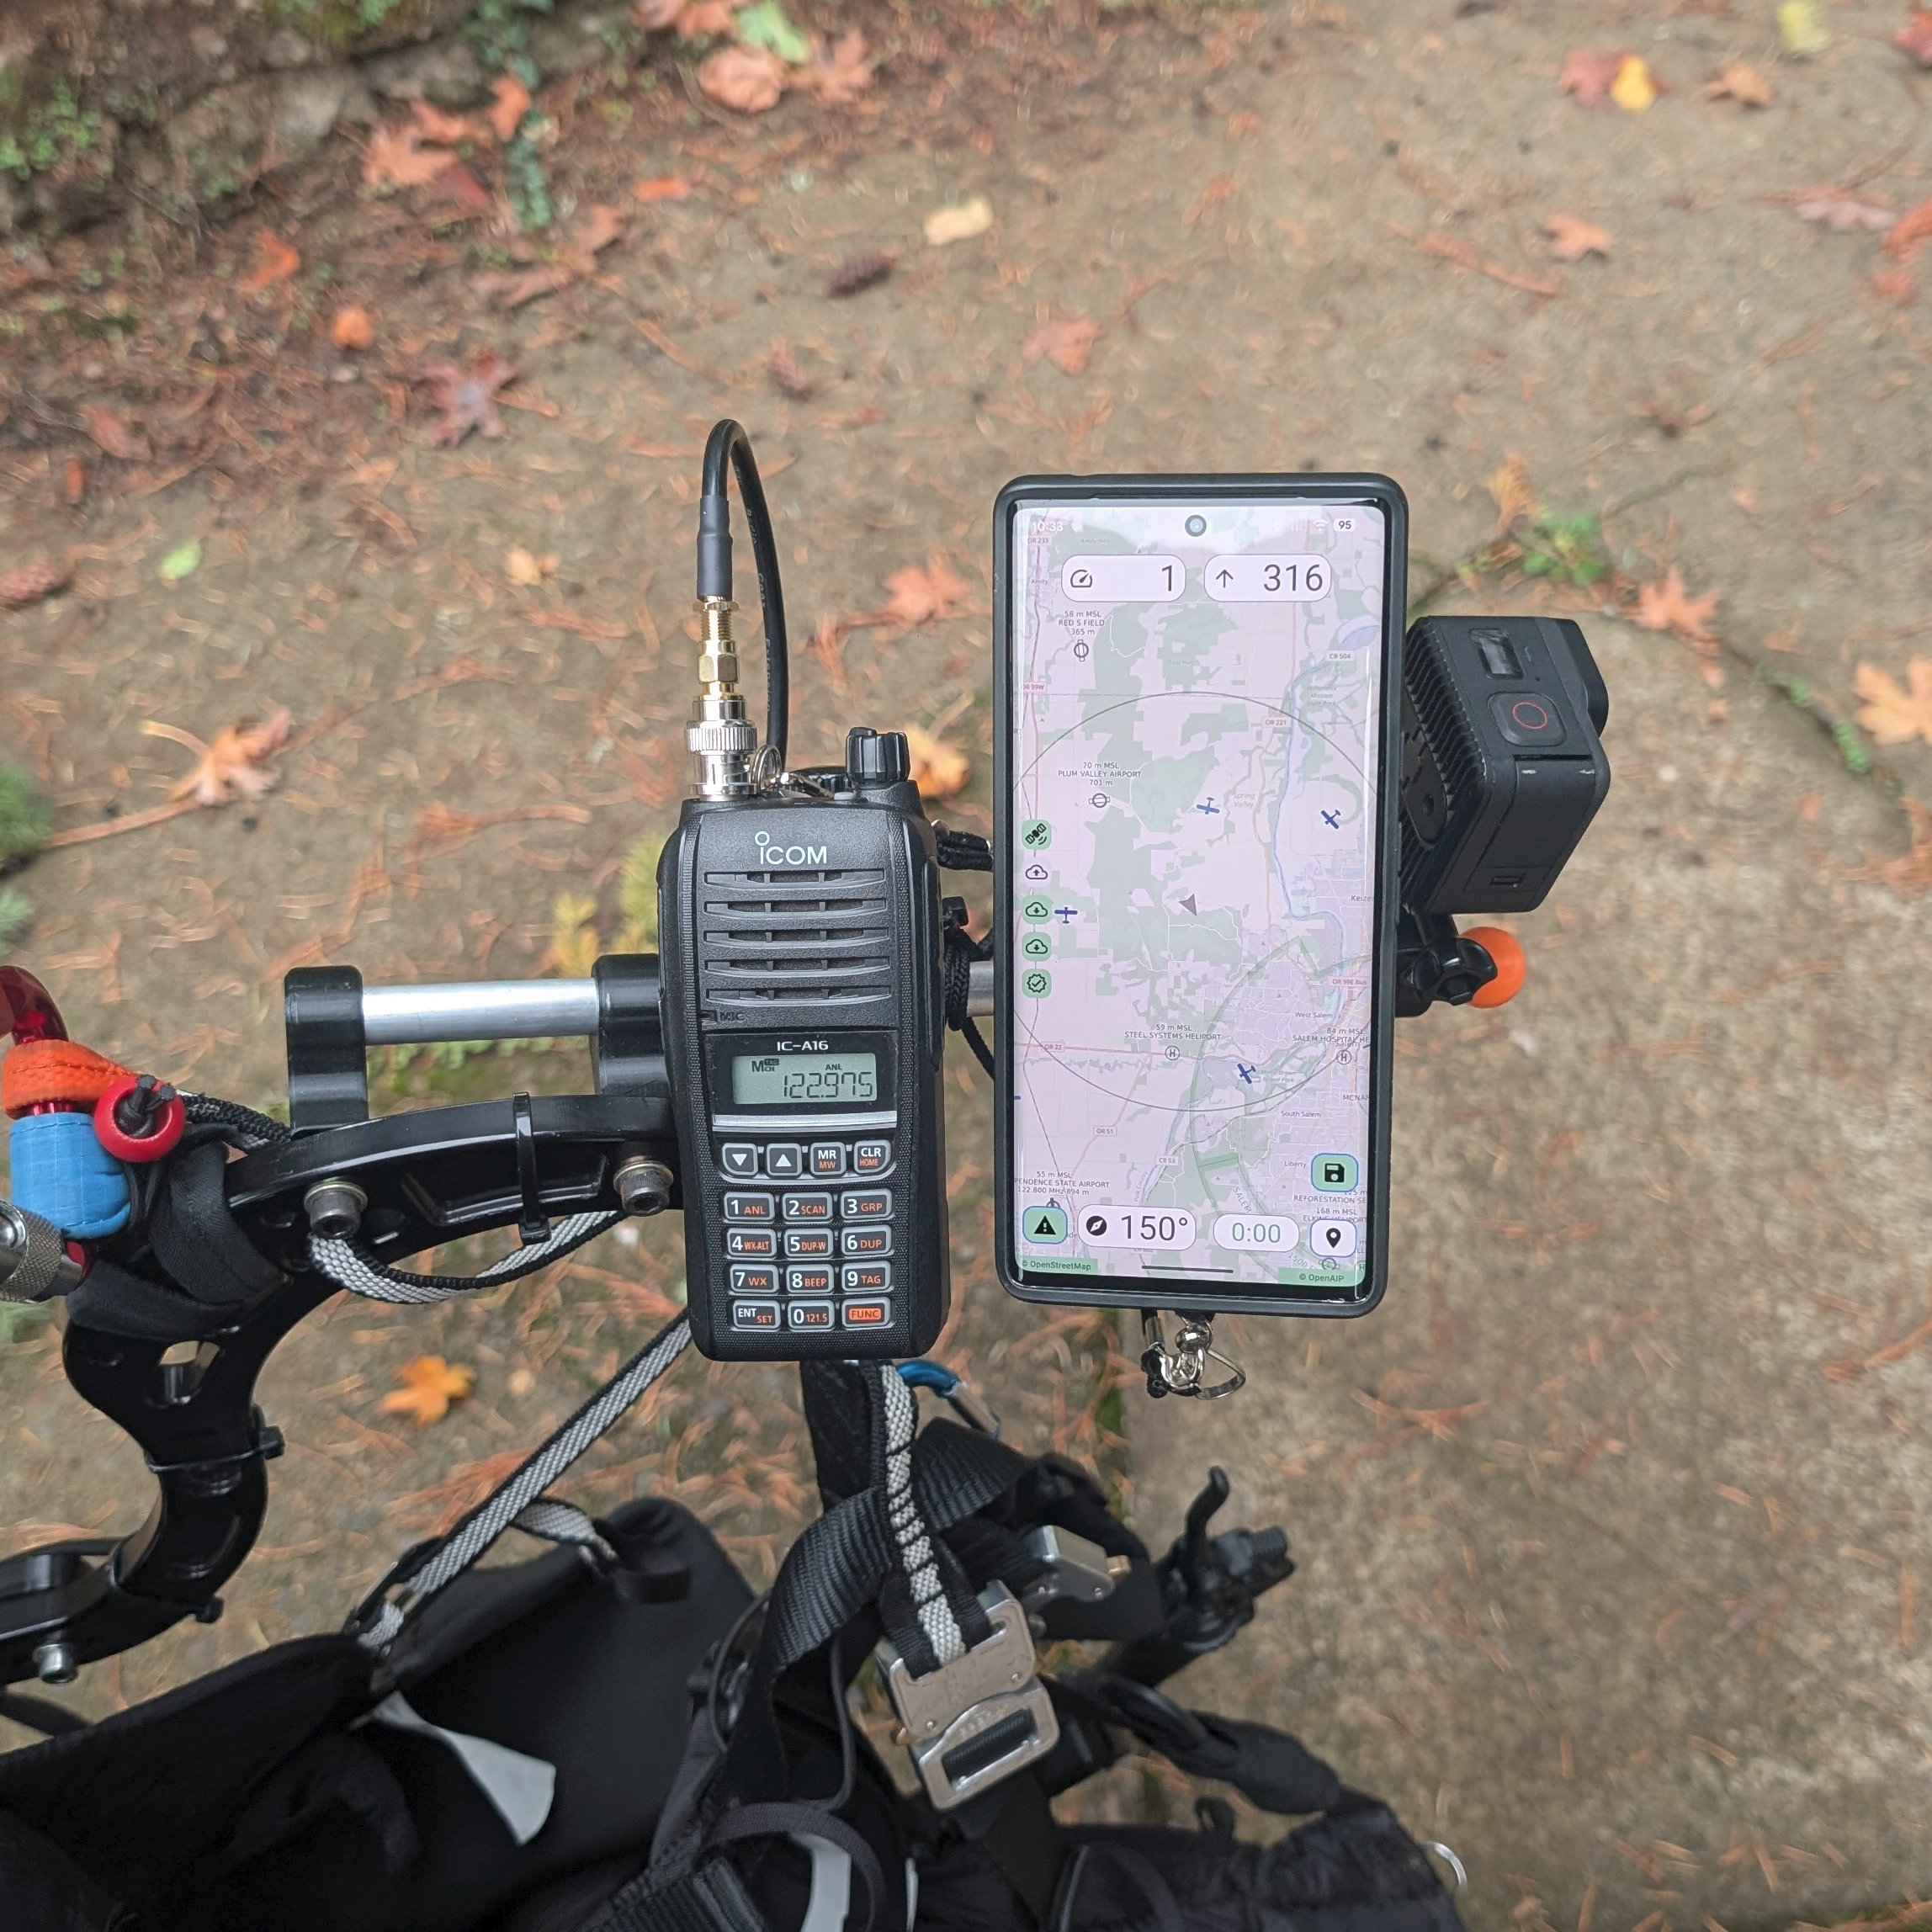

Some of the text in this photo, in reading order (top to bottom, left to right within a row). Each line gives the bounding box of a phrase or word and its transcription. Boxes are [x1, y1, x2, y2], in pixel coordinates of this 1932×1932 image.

[1032, 522, 1064, 532] 10:33
[1338, 520, 1352, 530] 95
[1161, 564, 1173, 592] 1
[1263, 564, 1323, 592] 316
[1232, 792, 1255, 800] Spring
[1234, 801, 1255, 809] Valley
[1149, 1032, 1183, 1040] SYSTEMS
[1185, 1032, 1222, 1041] HELIPORT
[777, 1040, 829, 1052] IC-A16
[825, 1063, 842, 1071] ANL
[818, 1149, 837, 1160] MR
[860, 1148, 882, 1158] CLR
[819, 1160, 836, 1169] MW
[859, 1158, 878, 1166] HOME
[1054, 1179, 1077, 1187] STATE
[1233, 1186, 1252, 1213] SALEM
[1293, 1195, 1356, 1204] REFORESTATION
[730, 1199, 766, 1215] 1 ANL
[788, 1200, 825, 1215] 2 SCAN
[847, 1198, 883, 1214] 3 GRP
[1121, 1214, 1188, 1241] 150°
[1232, 1221, 1281, 1244] 0:00
[731, 1235, 770, 1251] 4 WX-ALT
[790, 1236, 826, 1252] 5 DUP-W
[847, 1234, 883, 1250] 6 DUP
[1030, 1260, 1091, 1271] OpenStreetMap
[735, 1271, 768, 1287] 7 WX
[792, 1272, 827, 1288] 8 BEEP
[847, 1271, 881, 1287] 9 TAG
[1308, 1273, 1345, 1282] OpenAIP
[738, 1308, 756, 1318] ENT
[793, 1308, 827, 1324] 0 121.5
[851, 1309, 880, 1319] FUNC
[756, 1315, 772, 1324] SET
